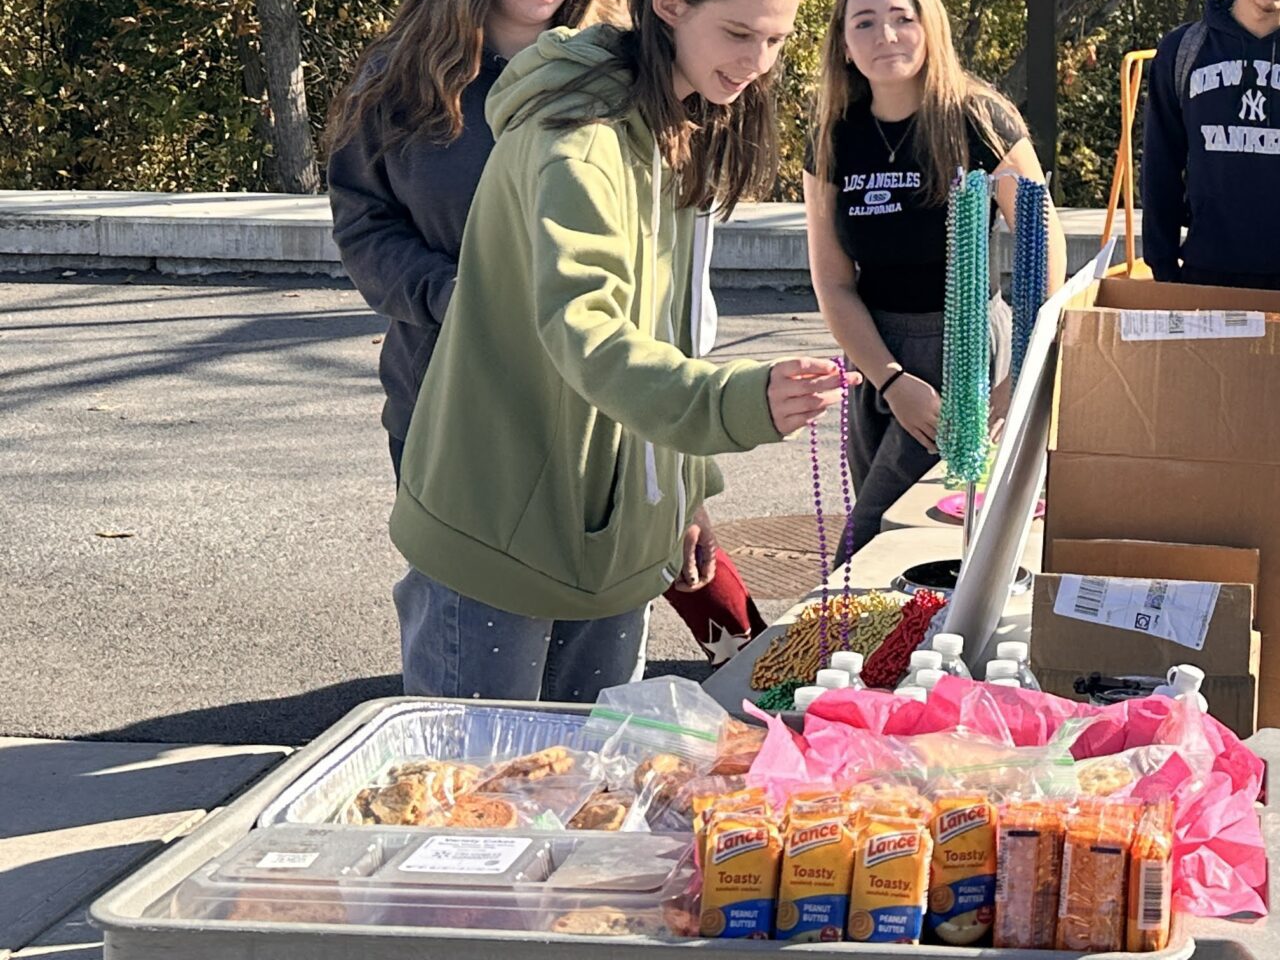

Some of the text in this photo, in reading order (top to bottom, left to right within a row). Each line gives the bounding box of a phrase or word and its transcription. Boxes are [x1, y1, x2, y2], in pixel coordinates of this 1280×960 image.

[1190, 59, 1243, 99] NEW
[843, 172, 920, 192] LOS ANGELES
[848, 203, 902, 216] CALIFORNIA
[938, 806, 986, 833] Lance
[716, 831, 764, 854] Lance
[790, 824, 839, 848] Lance
[867, 836, 917, 857] Lance
[730, 910, 759, 918] PEANUT
[803, 904, 832, 913] PEANUT
[729, 919, 757, 928] BUTTER
[802, 913, 829, 923] BUTTER
[879, 914, 908, 924] PEANUT
[878, 924, 905, 934] BUTTER
